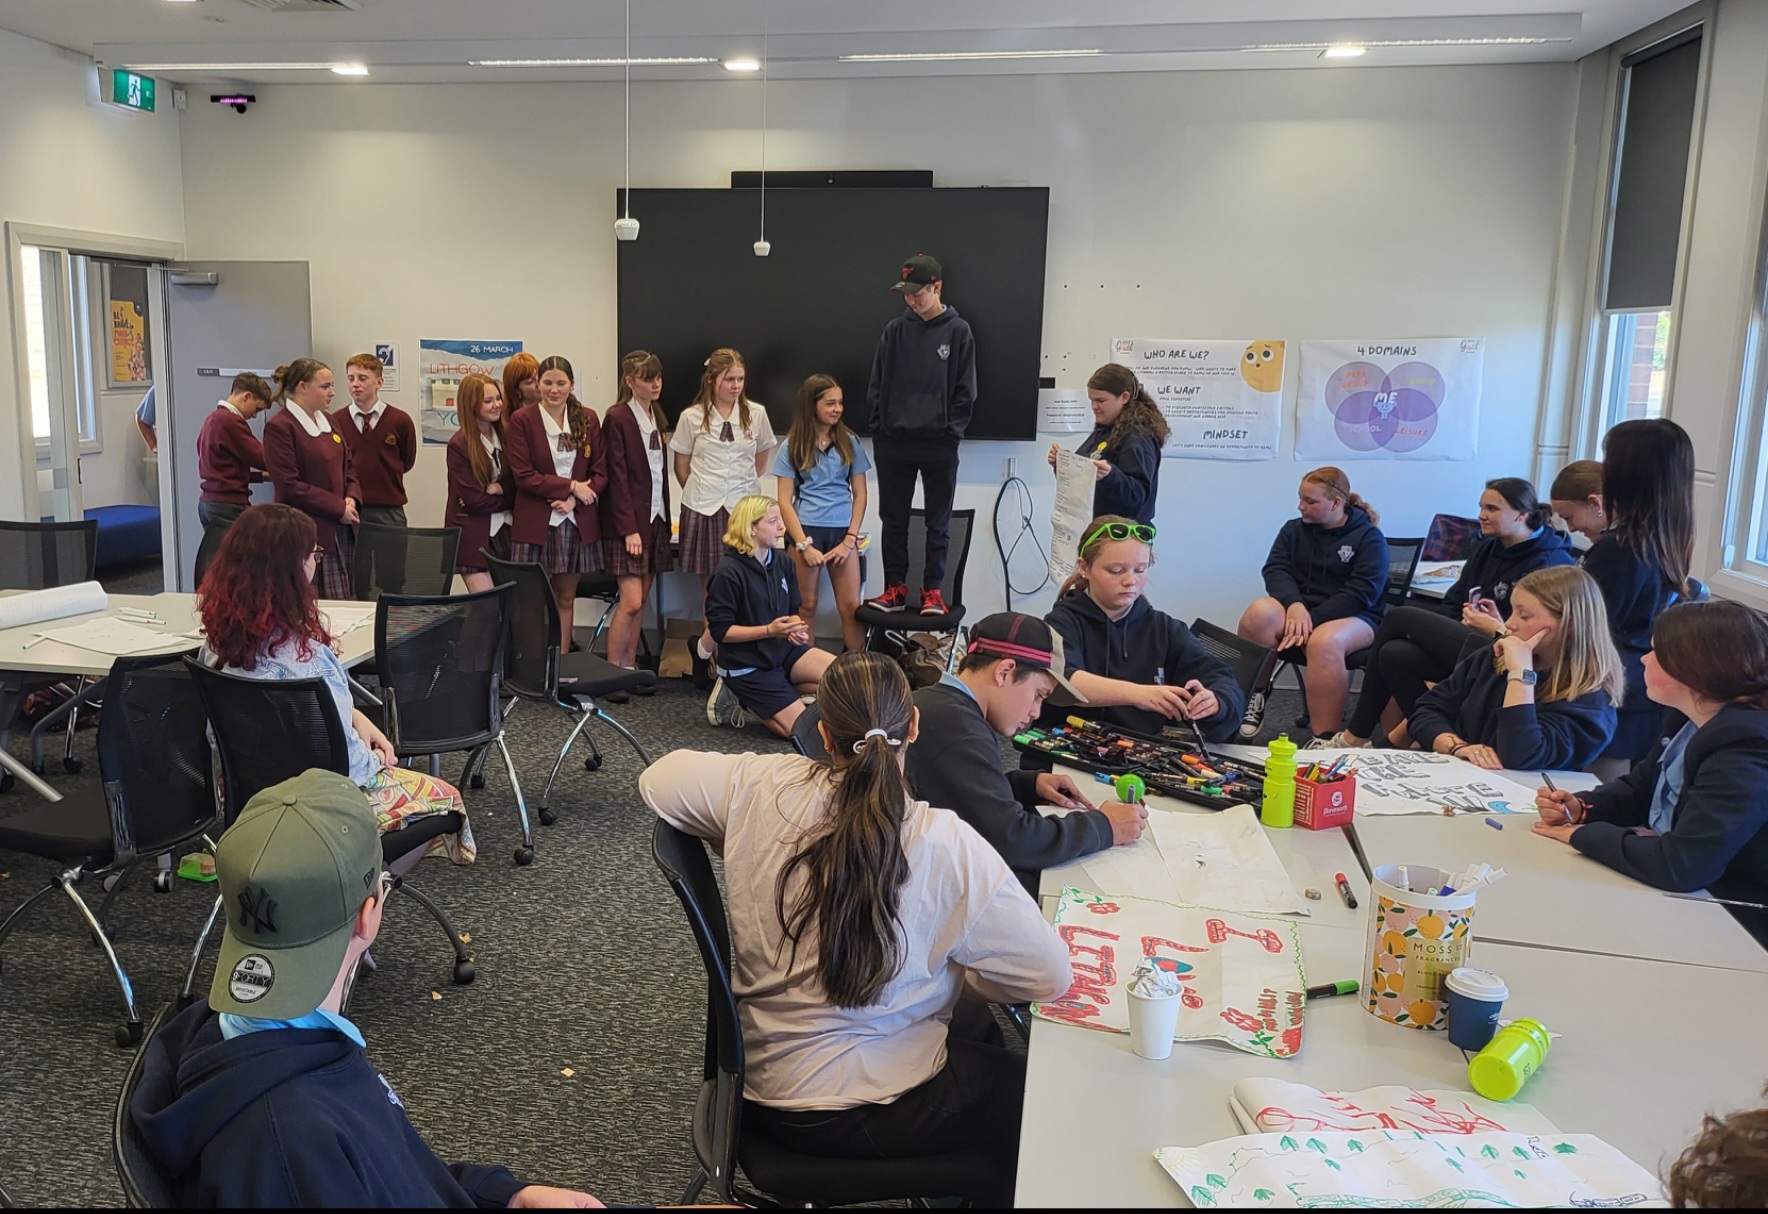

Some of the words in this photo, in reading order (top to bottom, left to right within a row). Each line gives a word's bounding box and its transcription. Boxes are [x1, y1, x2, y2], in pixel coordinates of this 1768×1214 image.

[470, 345, 480, 353] 26
[483, 345, 514, 353] MARCH
[1357, 346, 1365, 356] 4
[1368, 346, 1417, 356] DOMAINS
[1144, 350, 1165, 360] WHO
[1168, 350, 1187, 358] ARE
[1189, 350, 1209, 360] WE?
[429, 363, 495, 375] LITHGOW
[1157, 386, 1171, 395] WE
[1173, 386, 1201, 395] WANT
[1374, 392, 1398, 404] ME
[1203, 429, 1248, 440] MINDSET
[1396, 427, 1428, 437] LEISURE
[1413, 943, 1452, 954] MOSS
